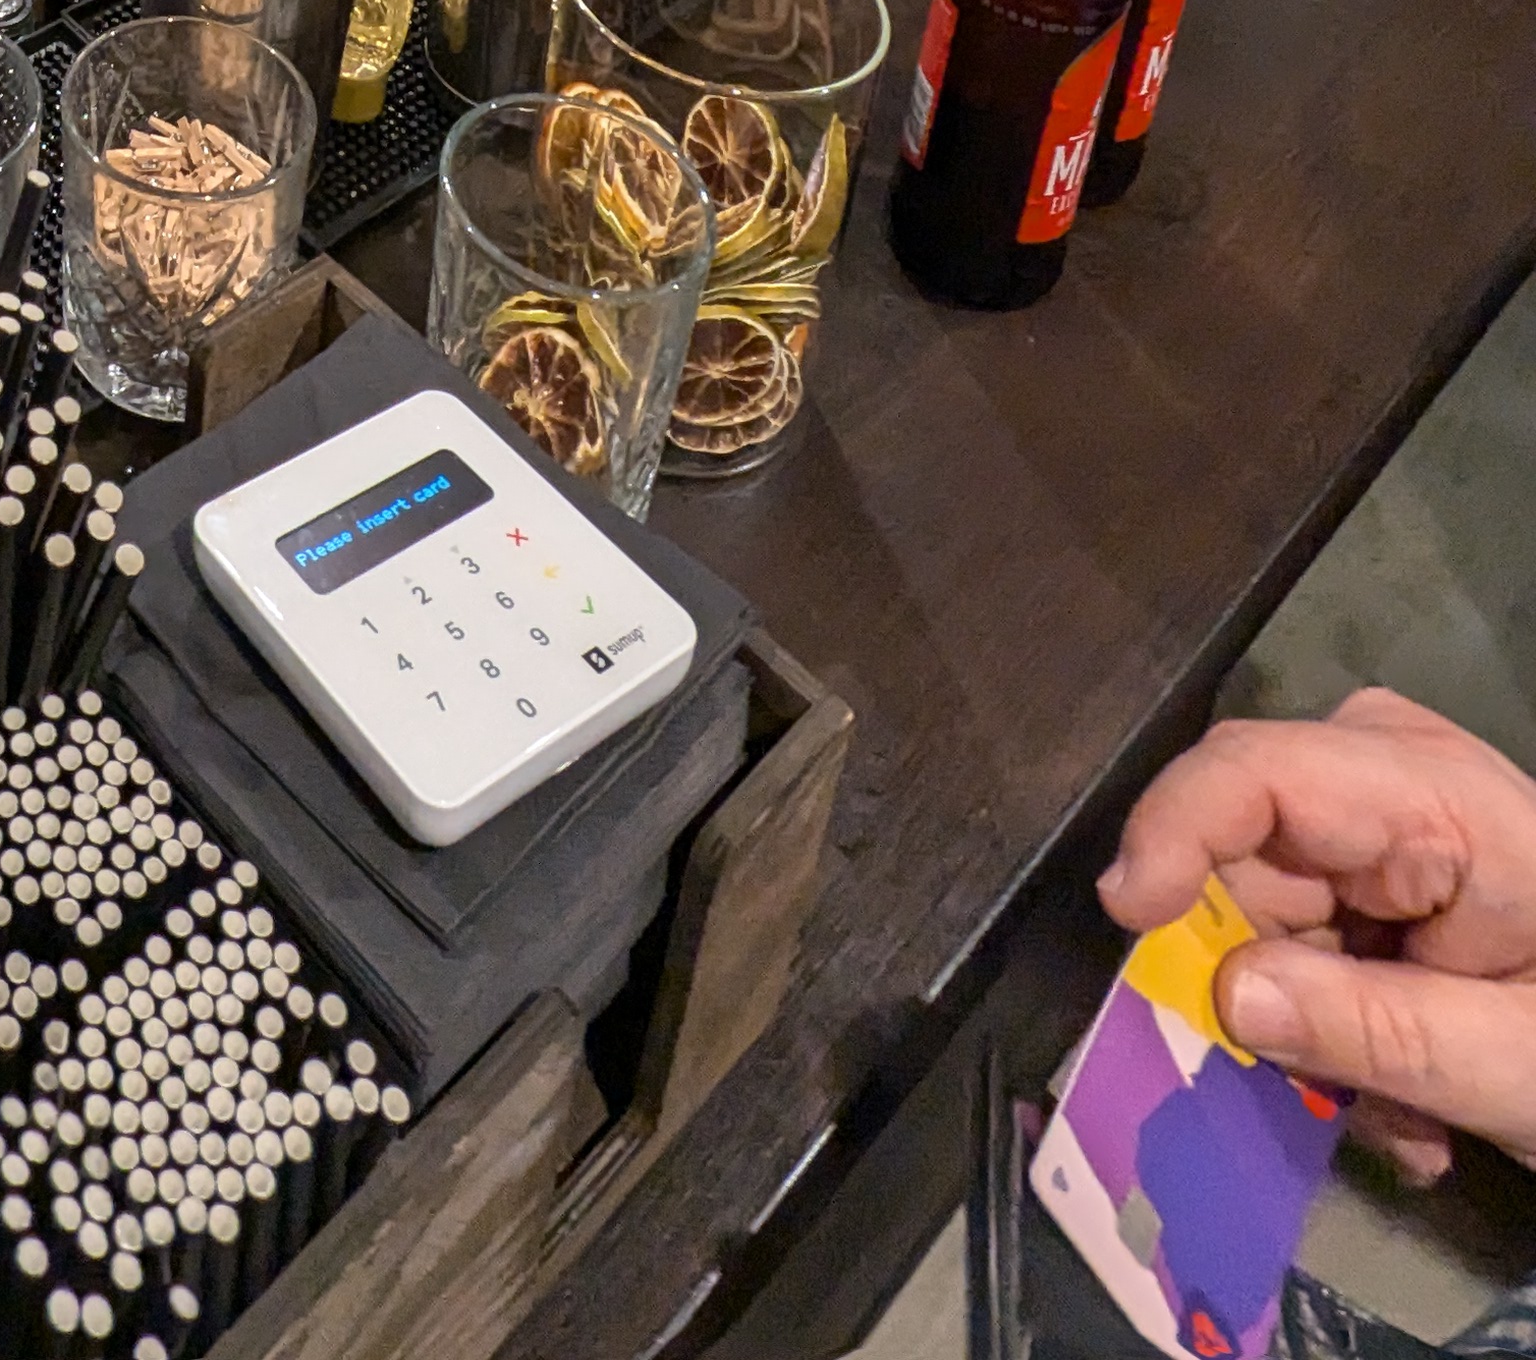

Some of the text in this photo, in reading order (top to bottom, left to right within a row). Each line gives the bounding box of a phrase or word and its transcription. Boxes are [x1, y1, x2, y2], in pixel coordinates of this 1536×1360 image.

[294, 473, 452, 568] Please insert card
[360, 556, 481, 635] 1 2 3
[396, 590, 515, 672] 4 5 6
[425, 627, 551, 713] 7 8 9
[515, 697, 538, 719] 0
